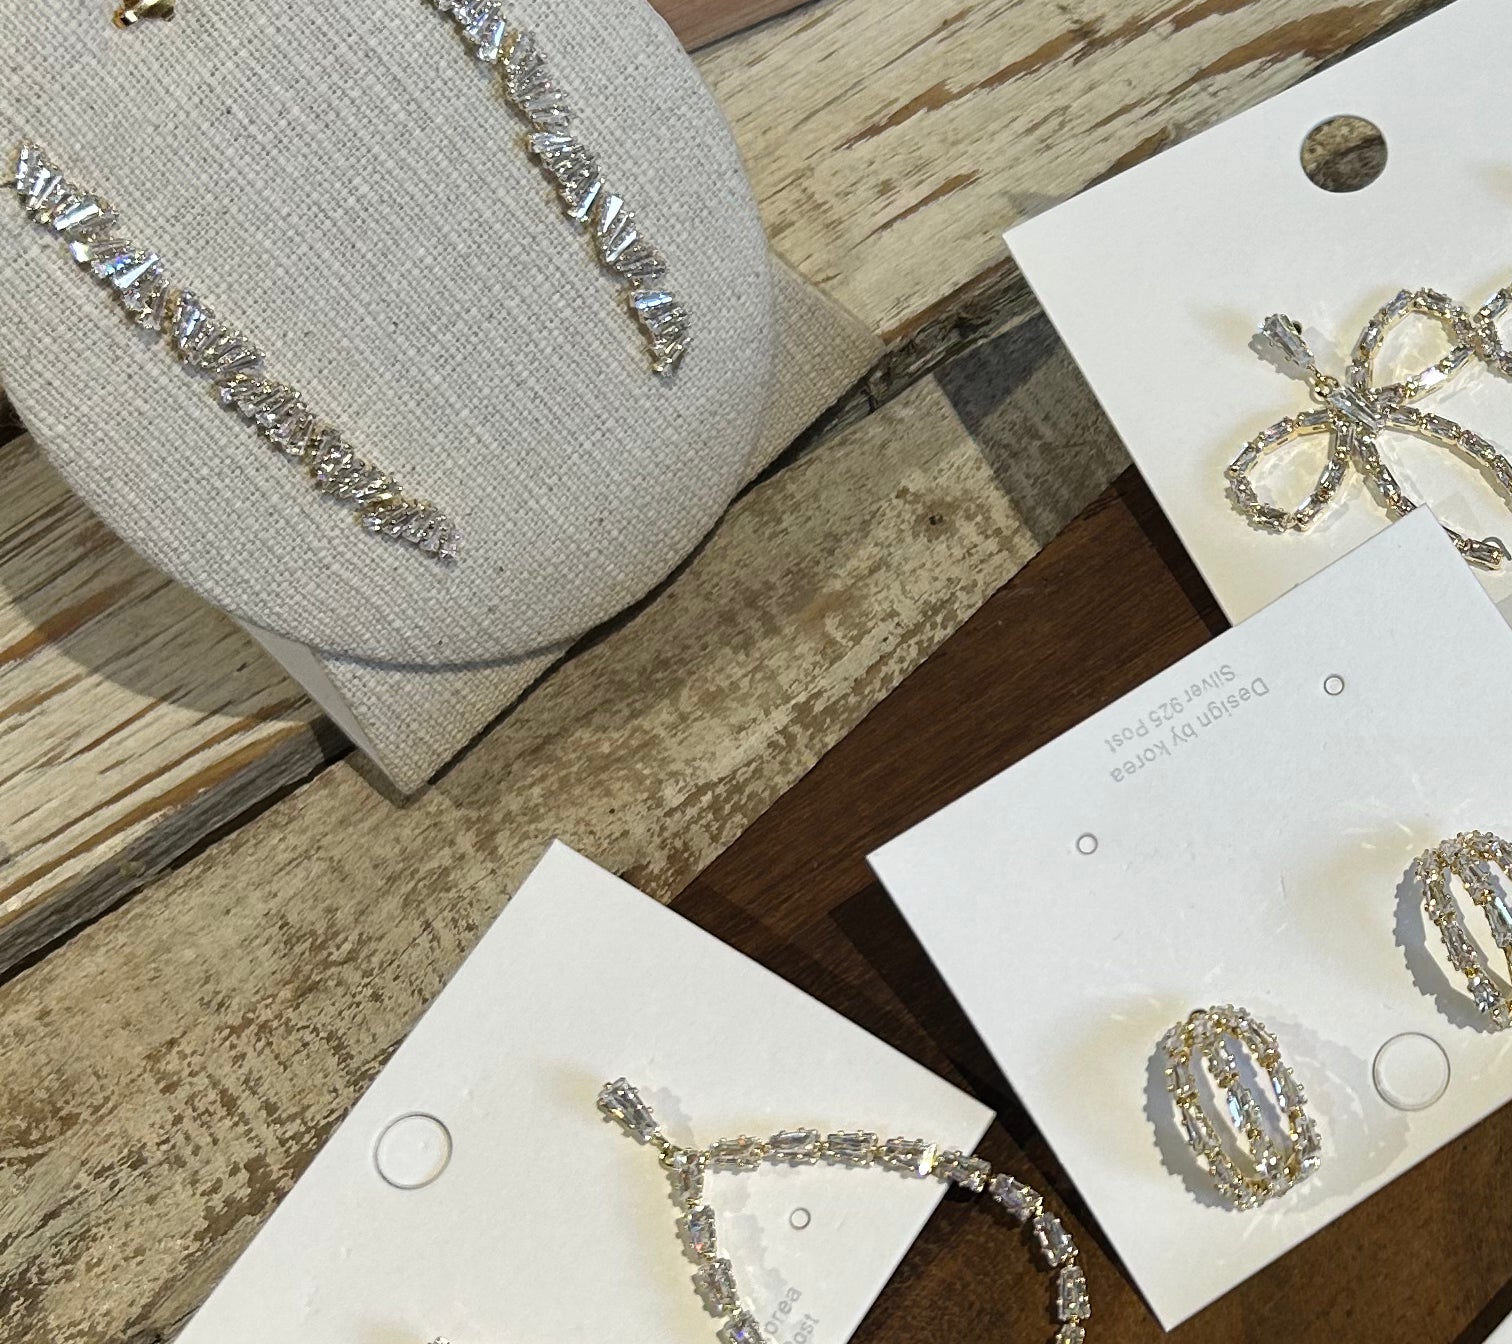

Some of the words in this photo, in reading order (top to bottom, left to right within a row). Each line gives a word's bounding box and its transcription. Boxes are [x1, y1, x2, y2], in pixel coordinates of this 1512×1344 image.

[1184, 664, 1236, 703] Silver
[1196, 677, 1270, 728] Design
[1150, 697, 1184, 728] 925
[1104, 719, 1149, 754] Post
[1170, 722, 1199, 747] by
[1110, 740, 1172, 783] korea
[763, 1287, 802, 1336] orea
